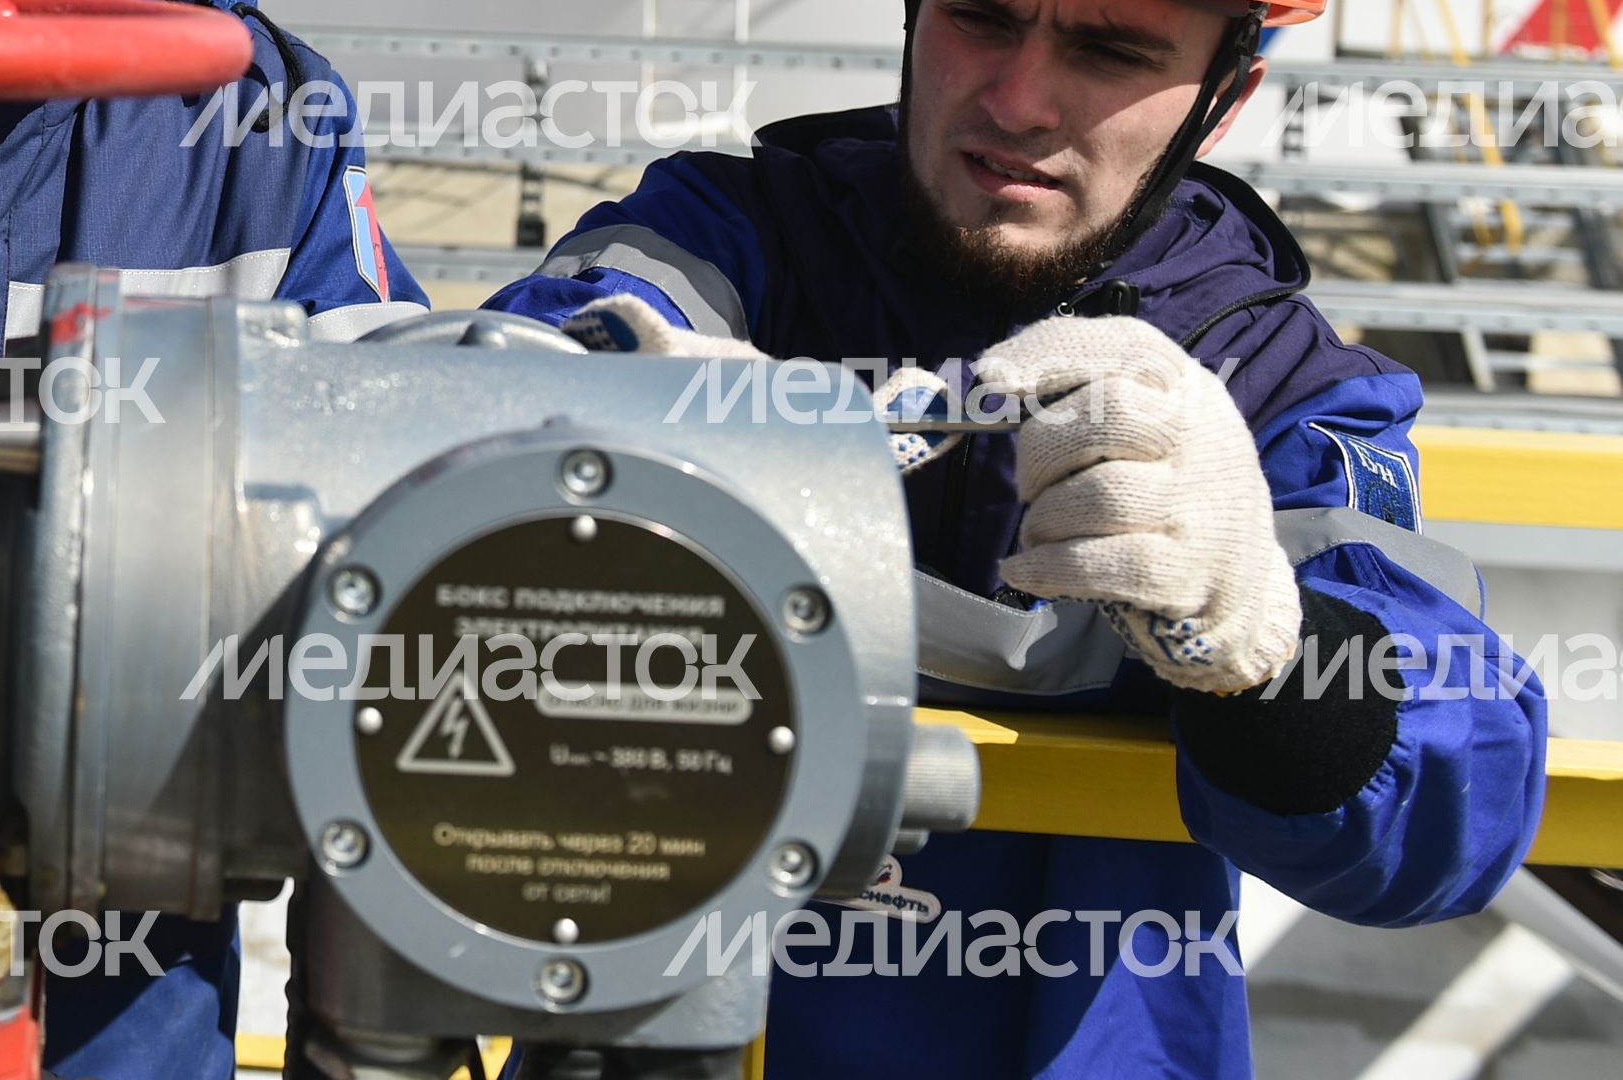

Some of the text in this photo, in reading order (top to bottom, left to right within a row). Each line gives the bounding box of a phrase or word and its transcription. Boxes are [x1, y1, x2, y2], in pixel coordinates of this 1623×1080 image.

[435, 583, 726, 618] БОКС ПОДКЛЮЧЕНИЯ
[626, 831, 658, 856] 20
[860, 889, 930, 914] снефть
